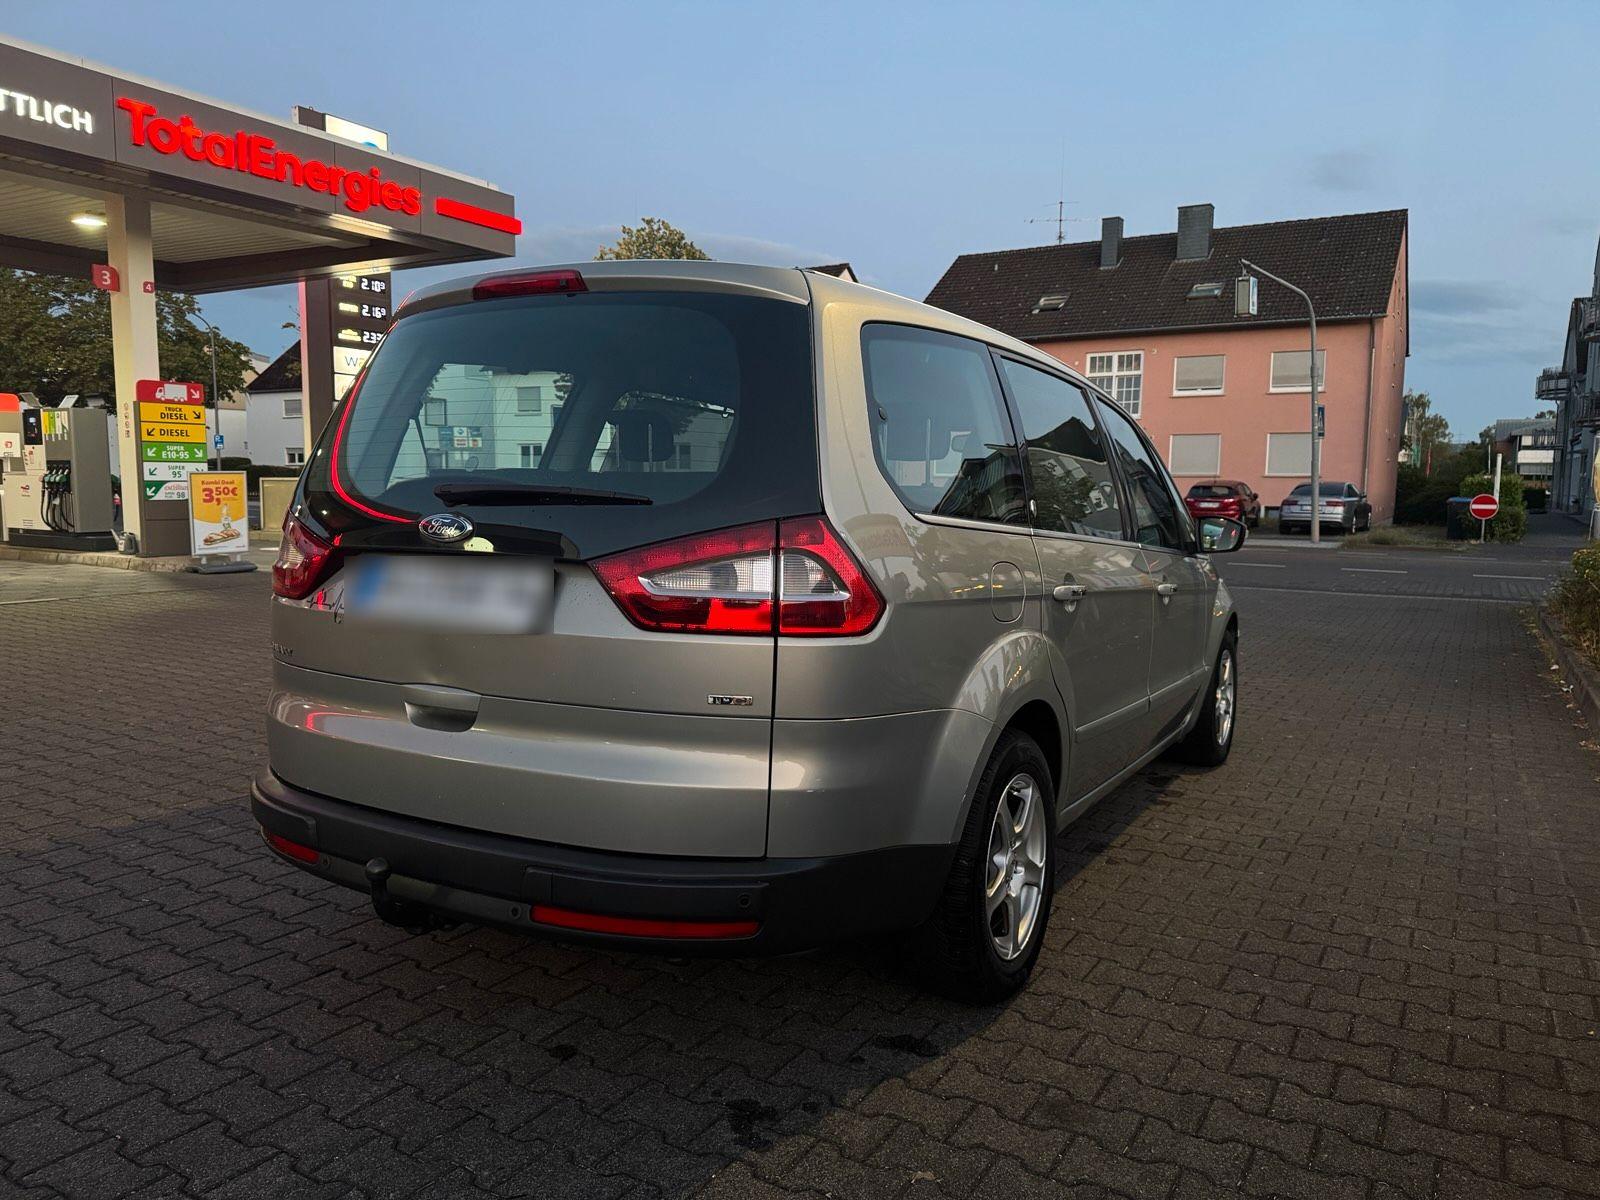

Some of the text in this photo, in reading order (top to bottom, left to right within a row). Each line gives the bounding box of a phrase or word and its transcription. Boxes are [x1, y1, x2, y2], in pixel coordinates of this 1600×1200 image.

[117, 97, 422, 216] TotalEnergies
[101, 270, 111, 285] 3
[145, 283, 152, 292] 4
[160, 411, 189, 421] DIESEL
[159, 428, 190, 437] DIESEL
[161, 450, 190, 459] E10-95
[171, 470, 182, 478] 95
[176, 491, 186, 499] 98
[427, 518, 458, 536] Ford
